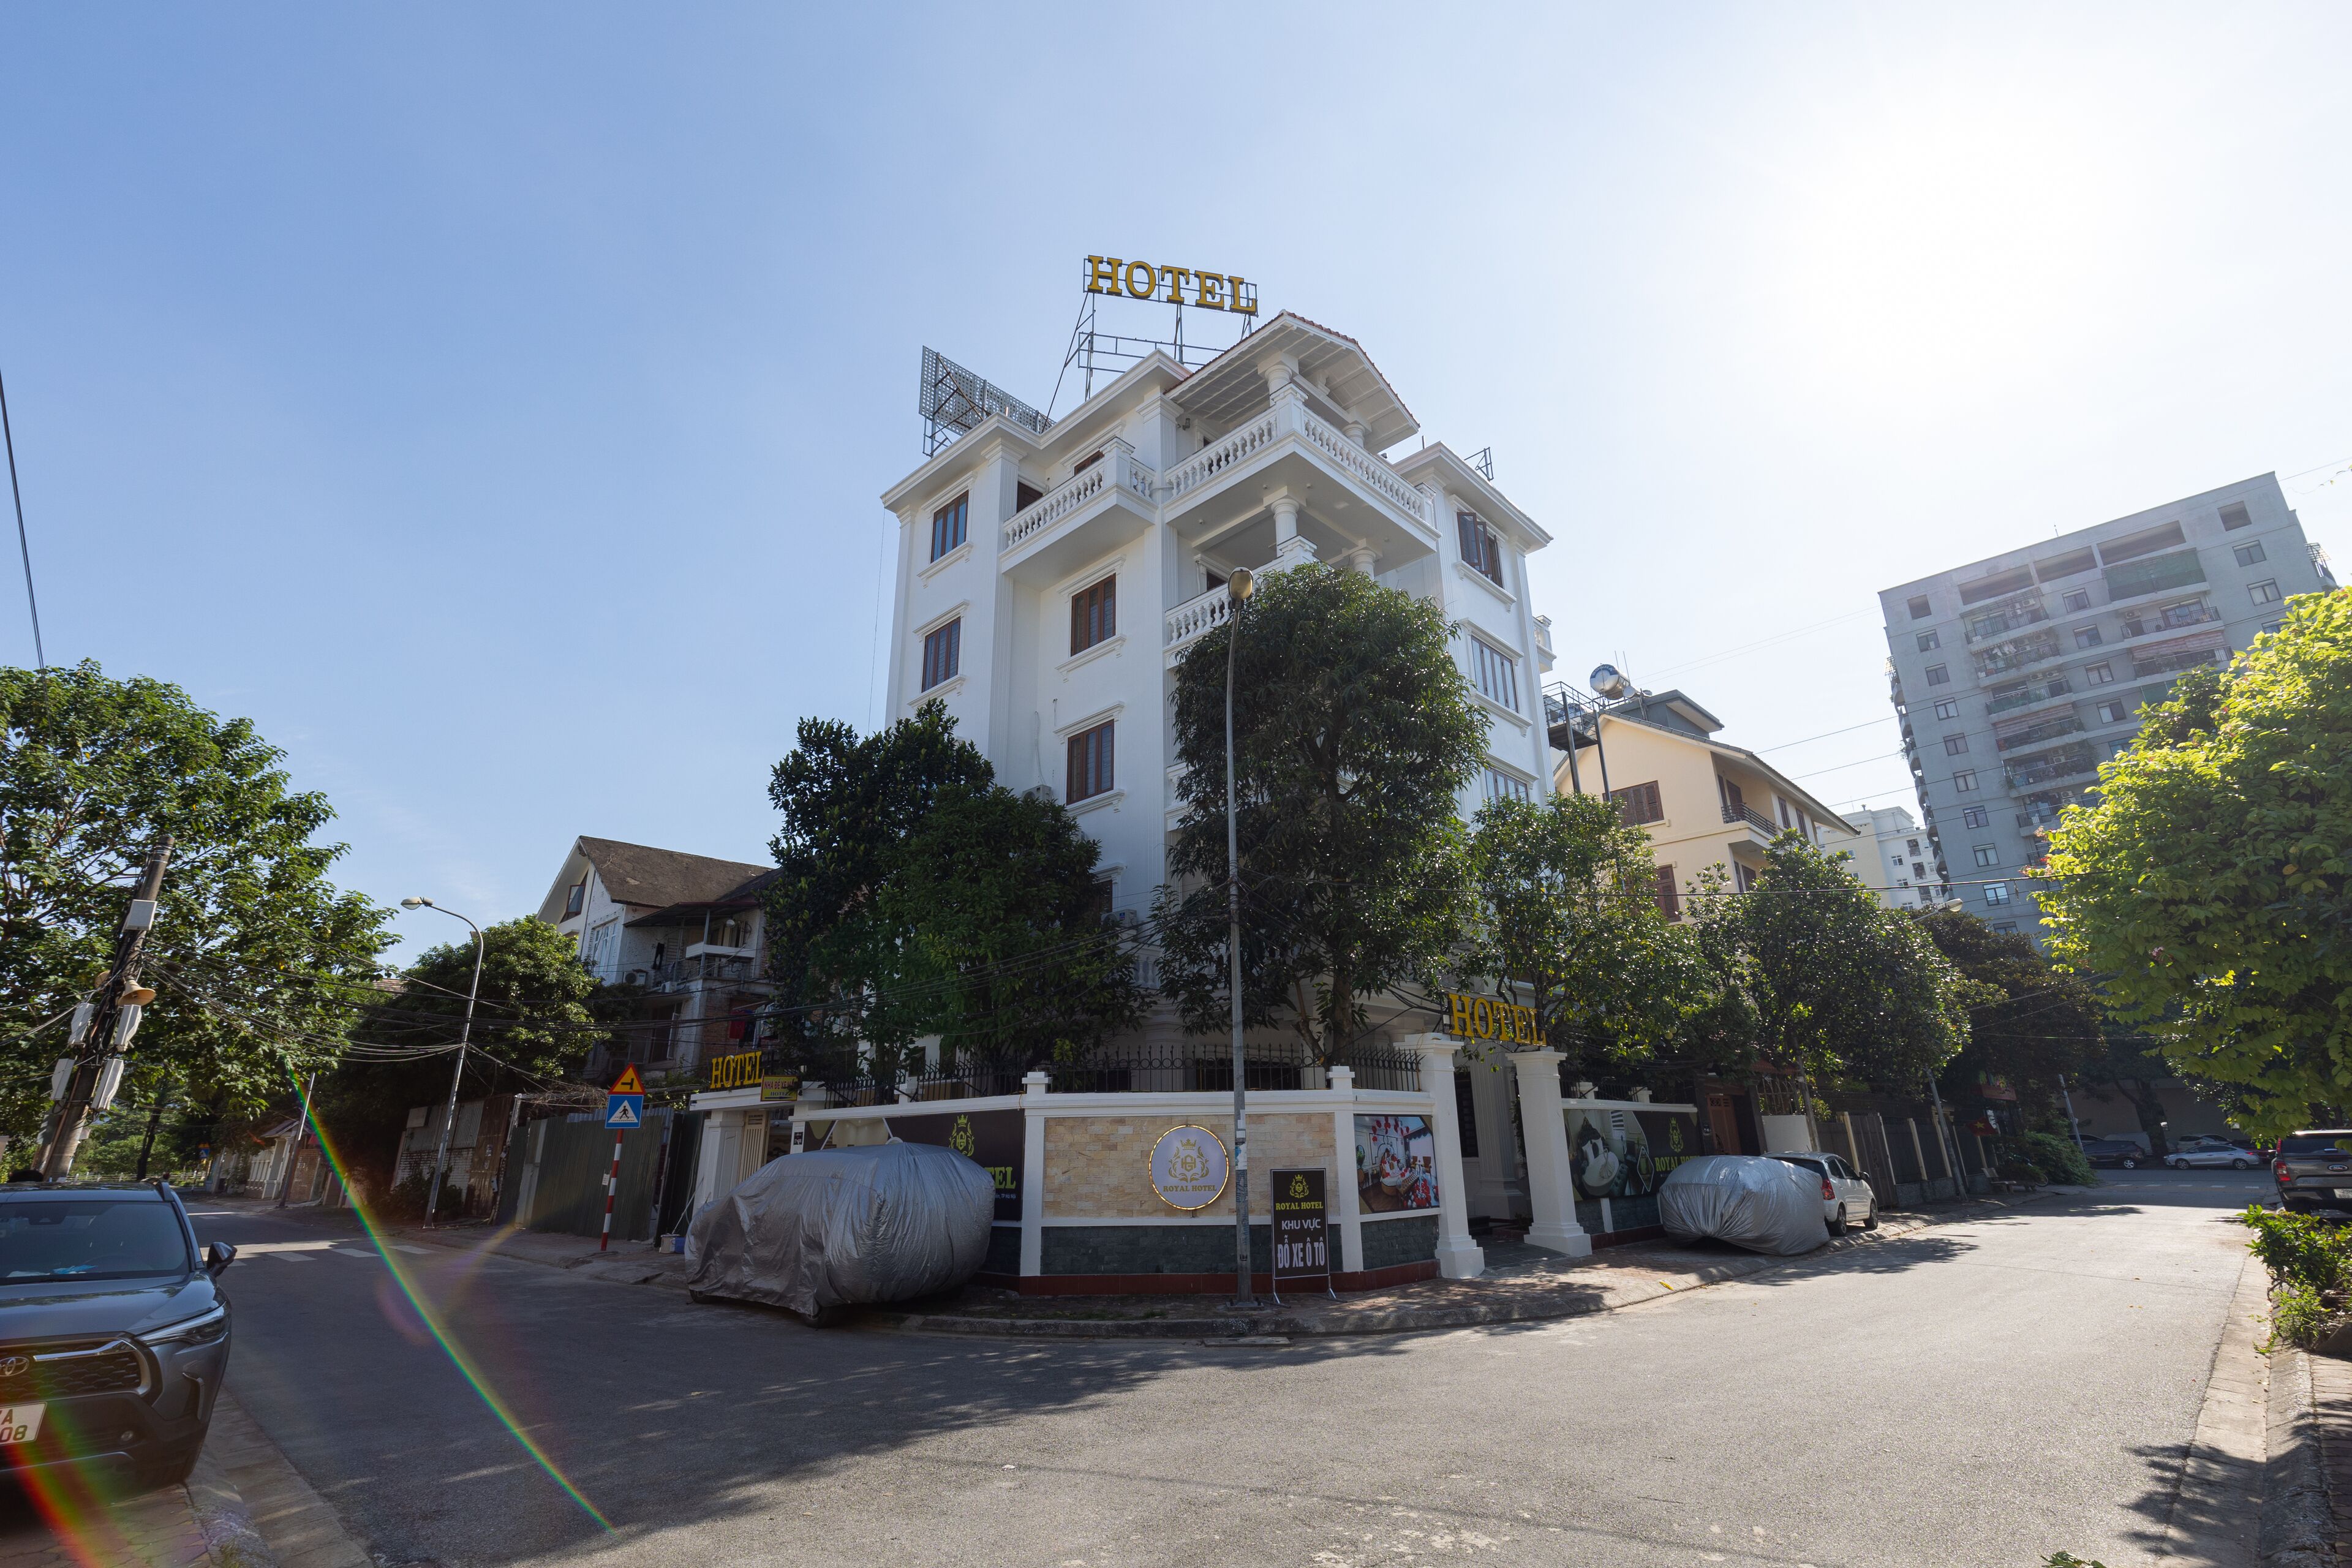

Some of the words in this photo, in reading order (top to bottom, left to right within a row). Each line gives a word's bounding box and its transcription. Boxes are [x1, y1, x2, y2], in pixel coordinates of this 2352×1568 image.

[1087, 255, 1256, 315] HOTEL
[1449, 993, 1547, 1047] HOTEL
[710, 1051, 762, 1088] HOTEL
[1654, 1156, 1678, 1171] ROYAL
[1281, 1220, 1300, 1230] KHU
[1302, 1218, 1321, 1231] VỰC
[1277, 1235, 1290, 1268] ĐỖ
[1292, 1243, 1304, 1267] XE
[1306, 1237, 1312, 1267] Ô
[1314, 1236, 1325, 1266] TÔ
